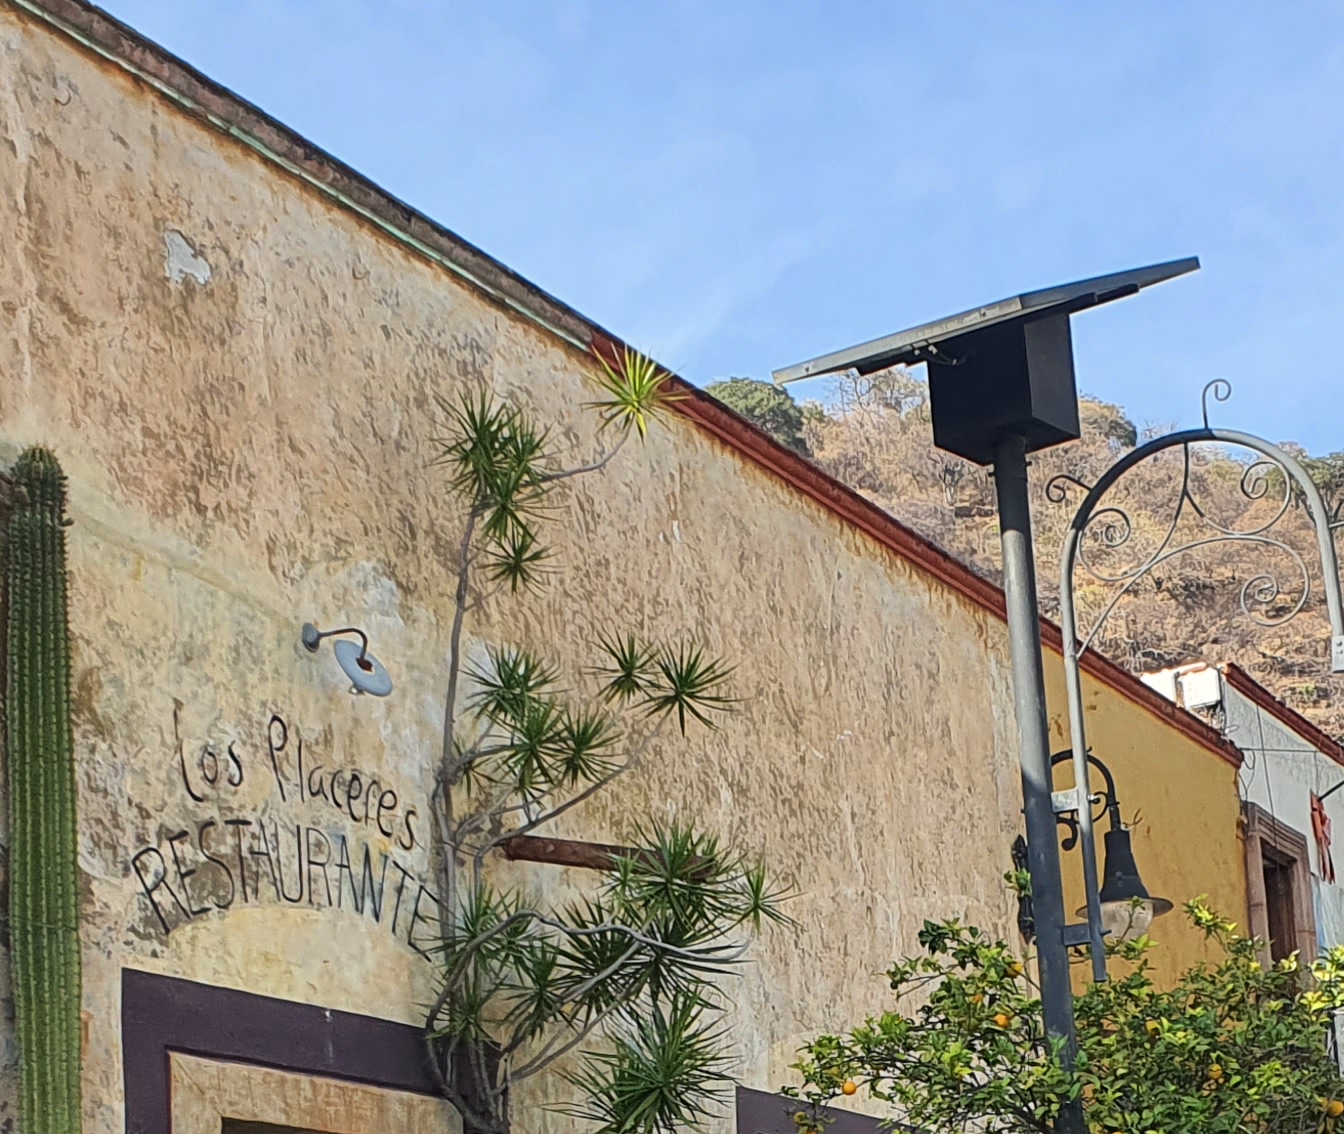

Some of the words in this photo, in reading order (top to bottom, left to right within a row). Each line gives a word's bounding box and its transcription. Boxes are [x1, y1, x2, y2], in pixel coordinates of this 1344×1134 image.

[173, 697, 243, 802] Los
[268, 714, 416, 850] Placeres
[131, 818, 438, 963] RESTAURANTE
